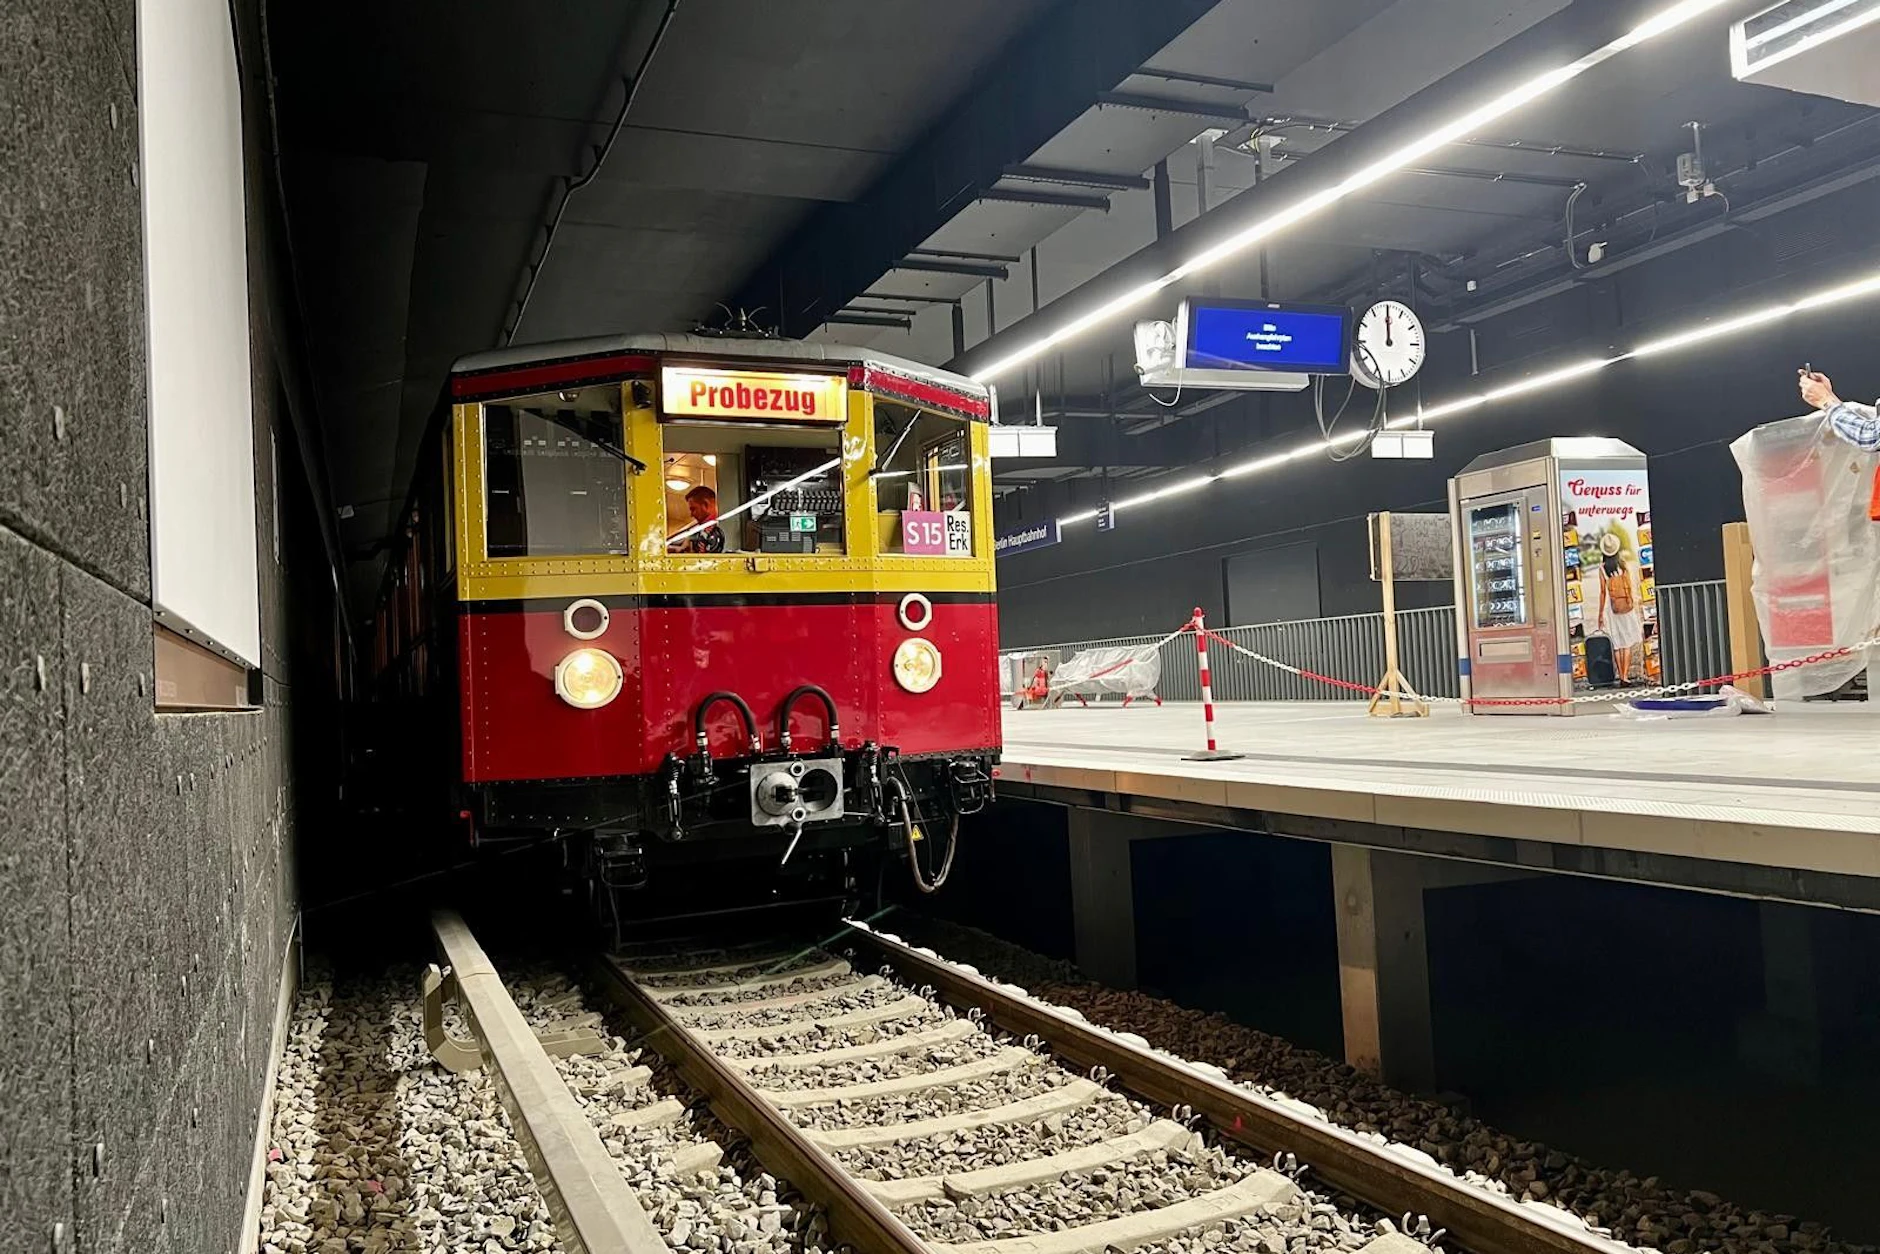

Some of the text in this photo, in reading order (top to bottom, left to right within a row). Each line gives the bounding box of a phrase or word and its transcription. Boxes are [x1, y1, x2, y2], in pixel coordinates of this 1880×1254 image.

[690, 380, 815, 415] Probezug
[1567, 478, 1622, 499] Genuss
[1578, 504, 1634, 521] unterwegs
[946, 514, 969, 533] Res.
[949, 533, 968, 551] Erk
[1007, 525, 1047, 547] Hauptbahnhof
